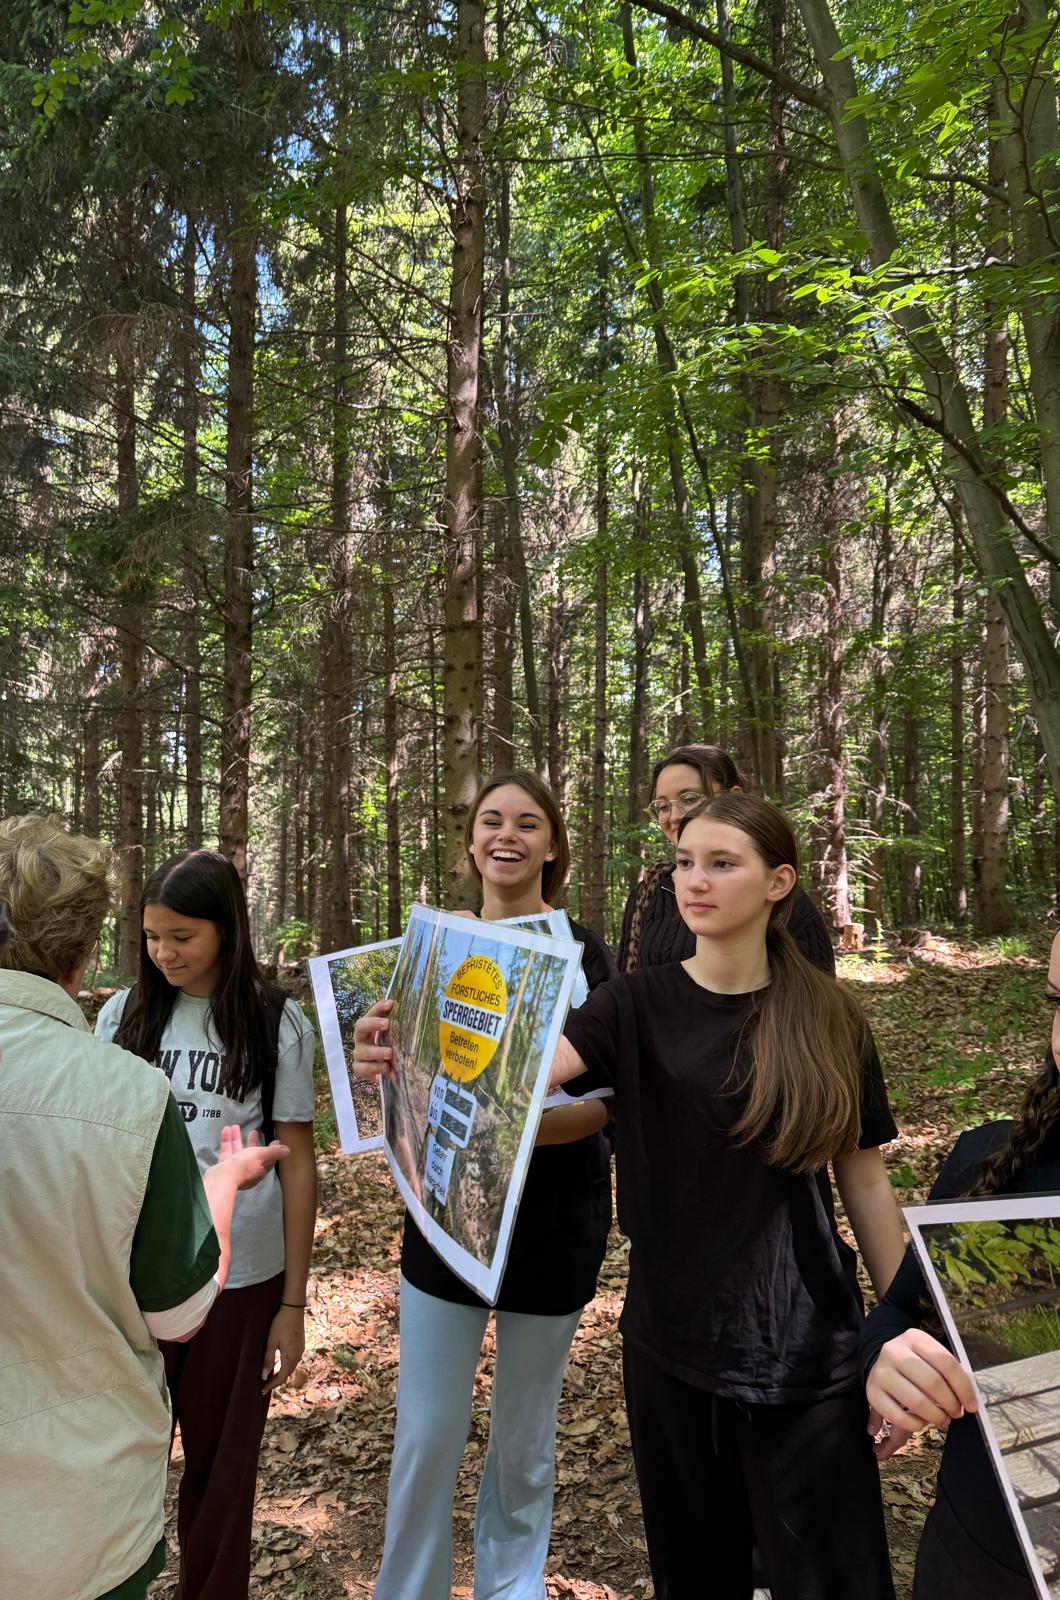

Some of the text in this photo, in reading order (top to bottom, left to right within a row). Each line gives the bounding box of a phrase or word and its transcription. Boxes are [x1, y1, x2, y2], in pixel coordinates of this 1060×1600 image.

[457, 959, 502, 990] BEFRISTETES
[451, 983, 501, 1007] FORSTLICHES
[443, 1000, 501, 1036] SPERRGEBIET
[449, 1031, 479, 1053] Betreten
[445, 1048, 478, 1070] verboten!
[202, 1109, 221, 1118] 1788
